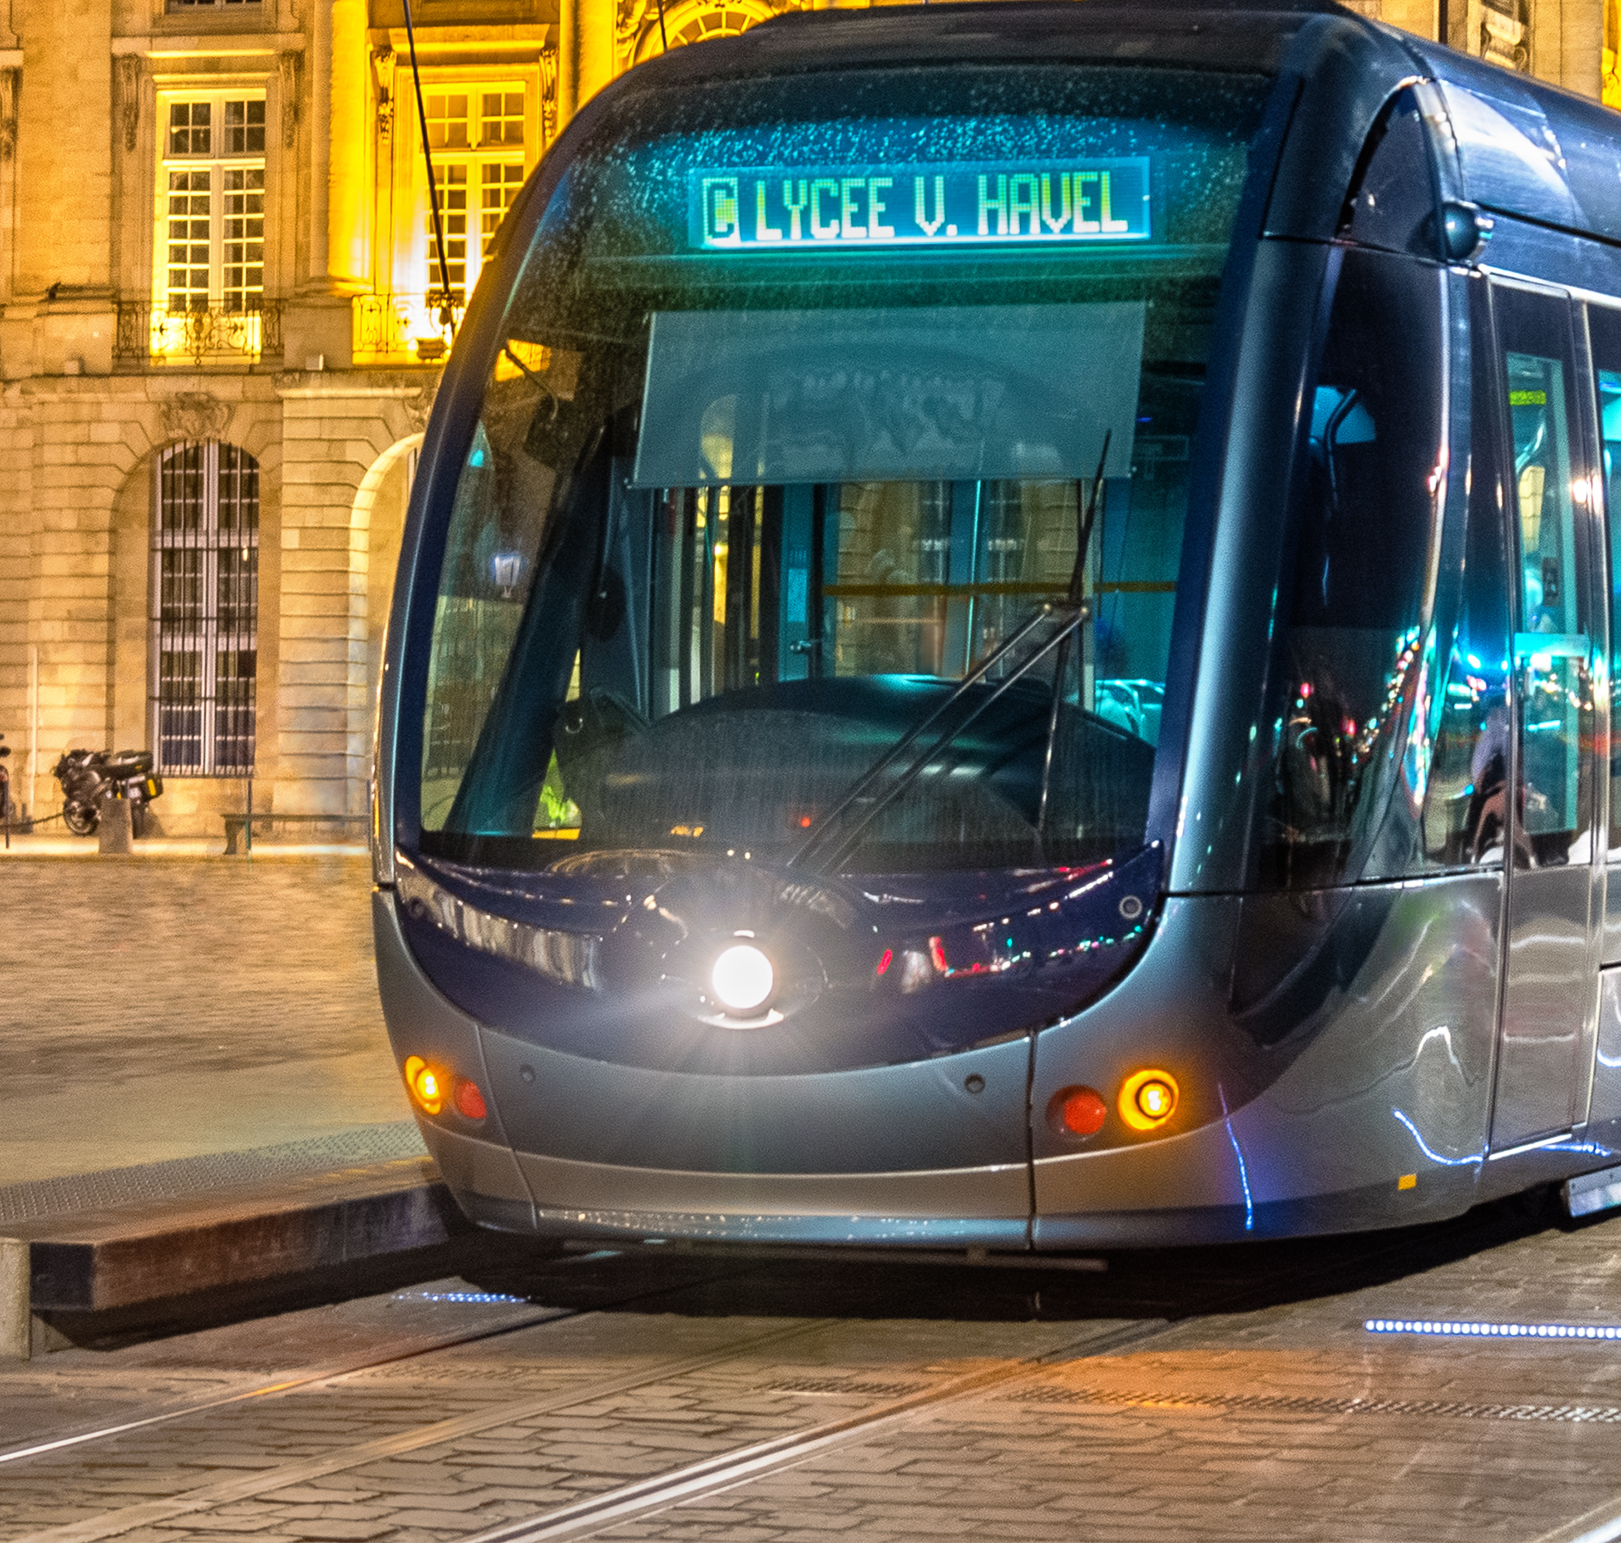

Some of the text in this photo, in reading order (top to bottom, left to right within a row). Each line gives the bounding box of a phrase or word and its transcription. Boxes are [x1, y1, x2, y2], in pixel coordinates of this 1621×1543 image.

[756, 176, 895, 240] LYCEE
[915, 175, 958, 237] V.
[978, 171, 1129, 235] HAVEL
